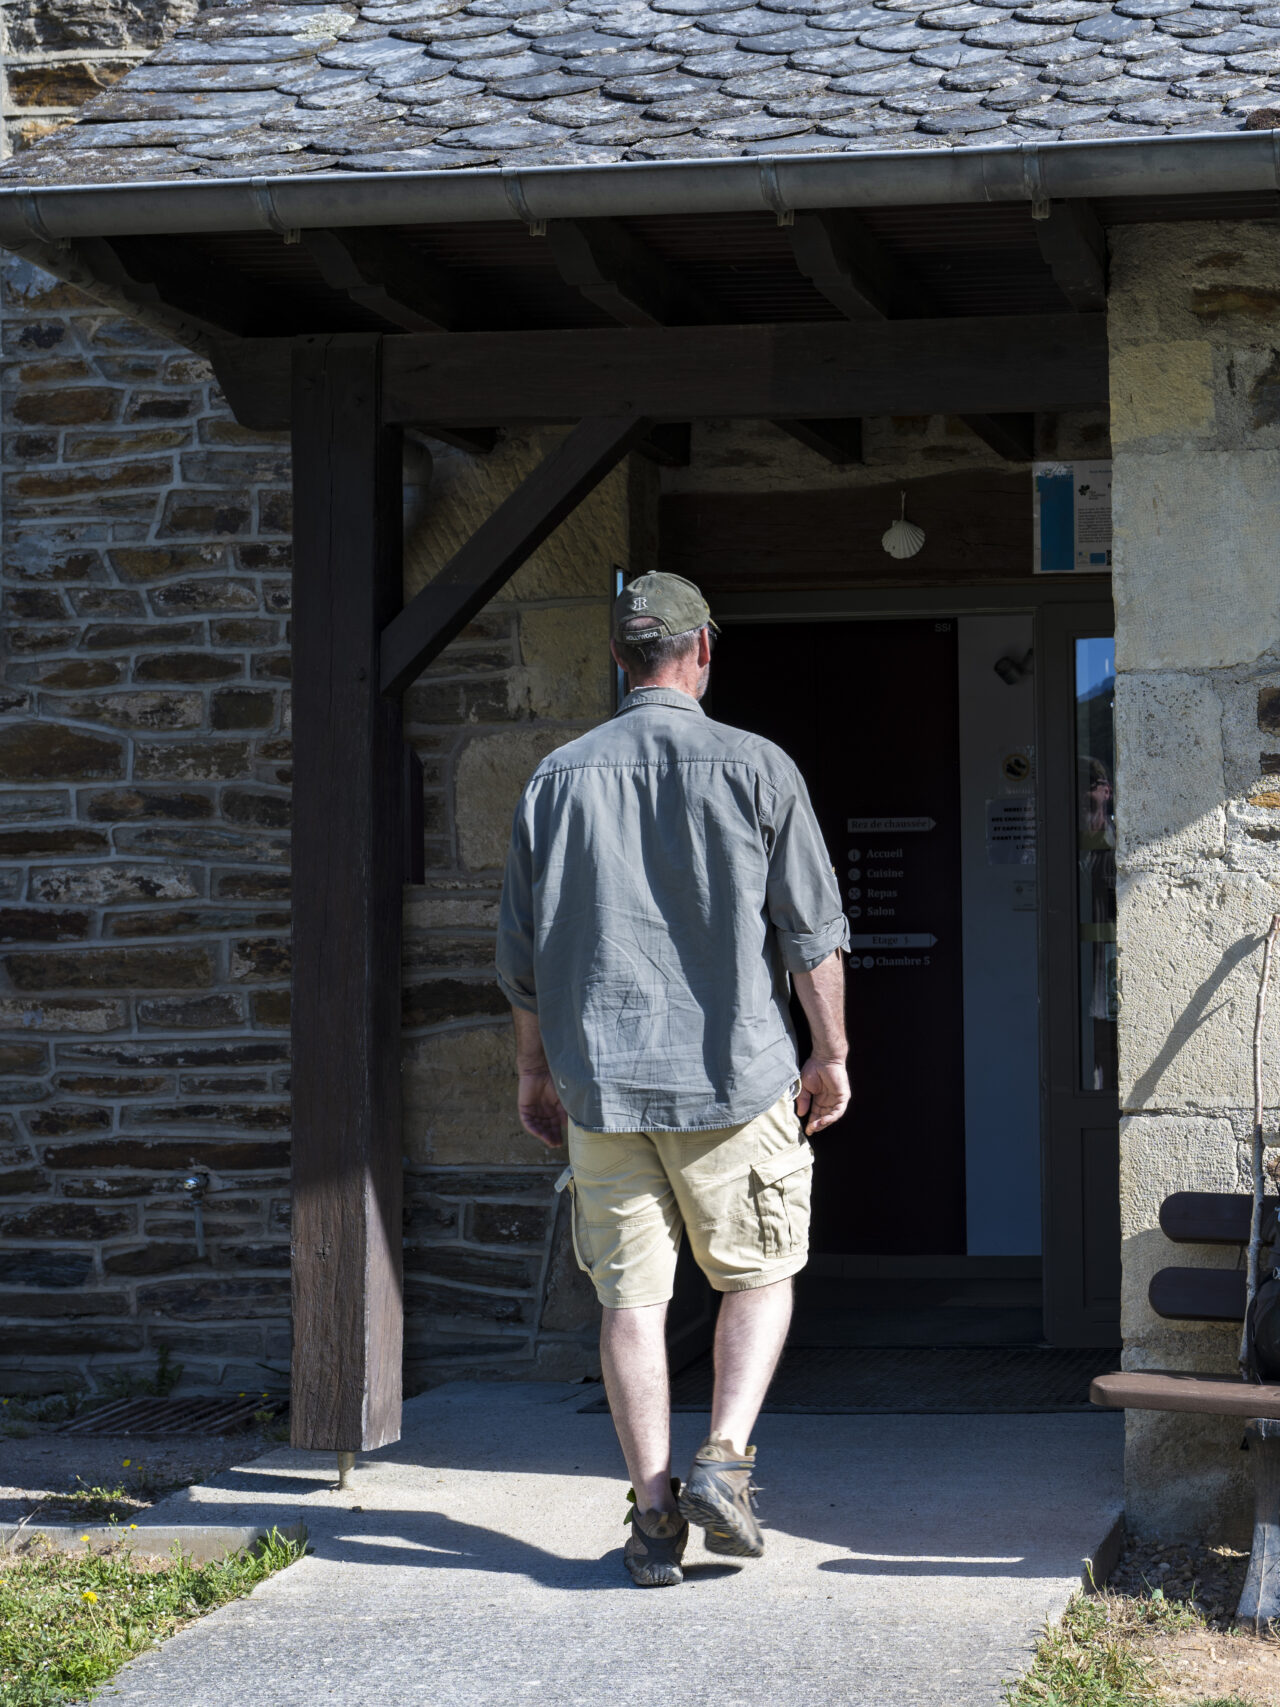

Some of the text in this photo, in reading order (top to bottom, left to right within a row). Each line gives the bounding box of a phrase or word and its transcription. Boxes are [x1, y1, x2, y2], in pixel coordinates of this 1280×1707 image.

[626, 632, 658, 640] HOLLYWOOD
[851, 818, 928, 829] Rez de chaussée
[866, 848, 903, 859] Accueil
[866, 867, 904, 878] Cuisine
[867, 888, 898, 901] Repas
[867, 906, 896, 917] Salon
[872, 935, 898, 946] Etage
[875, 955, 931, 967] Chambre 5
